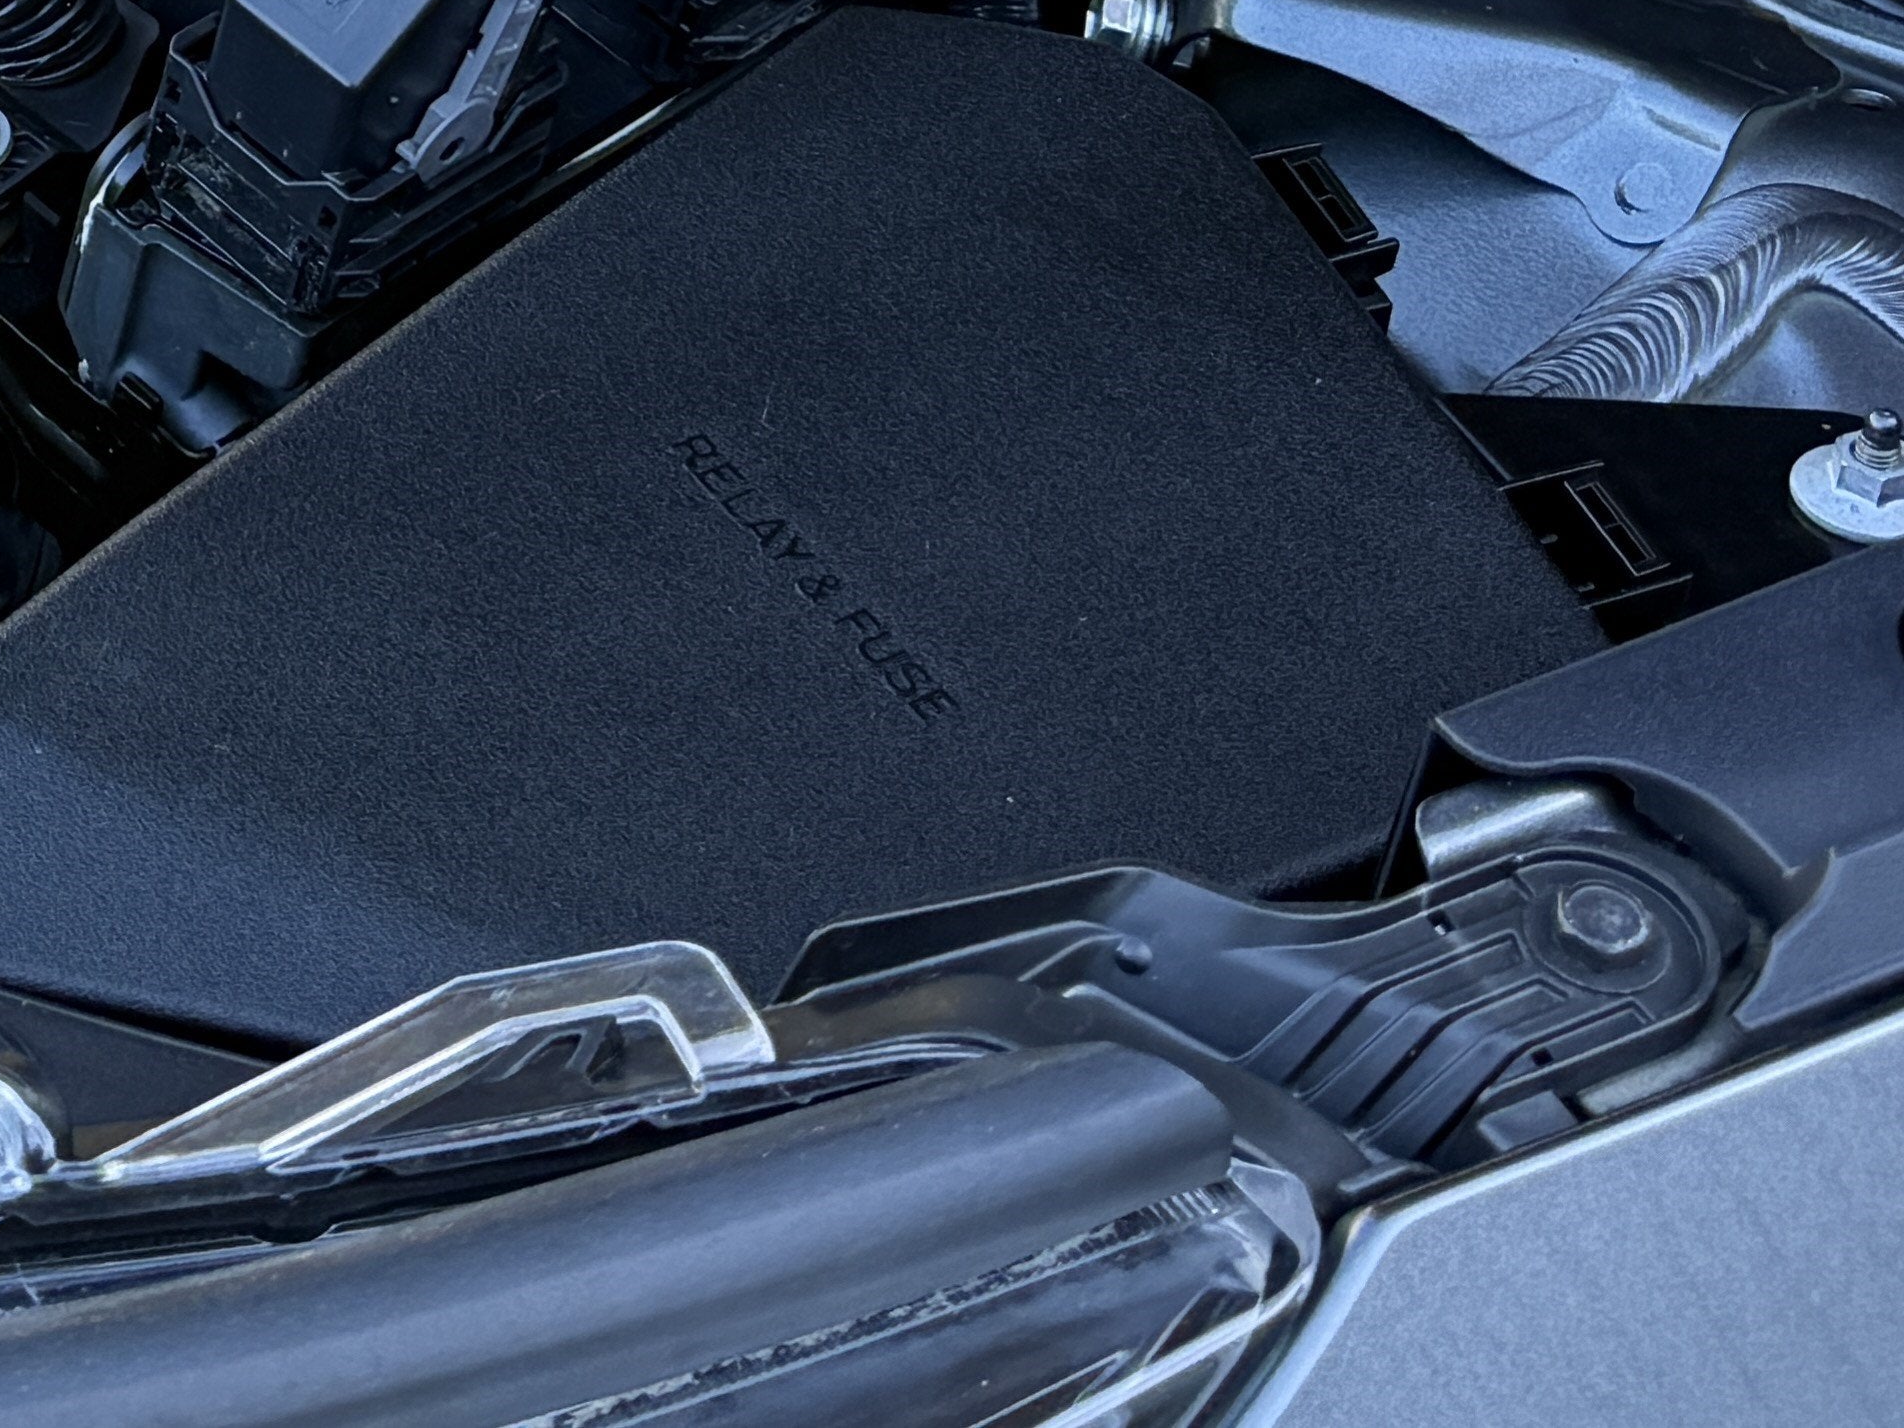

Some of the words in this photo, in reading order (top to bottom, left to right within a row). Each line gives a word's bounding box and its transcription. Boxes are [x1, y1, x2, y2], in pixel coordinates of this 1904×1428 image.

[673, 435, 816, 560] RELAY
[796, 574, 840, 603] &
[835, 609, 959, 722] FUSE
